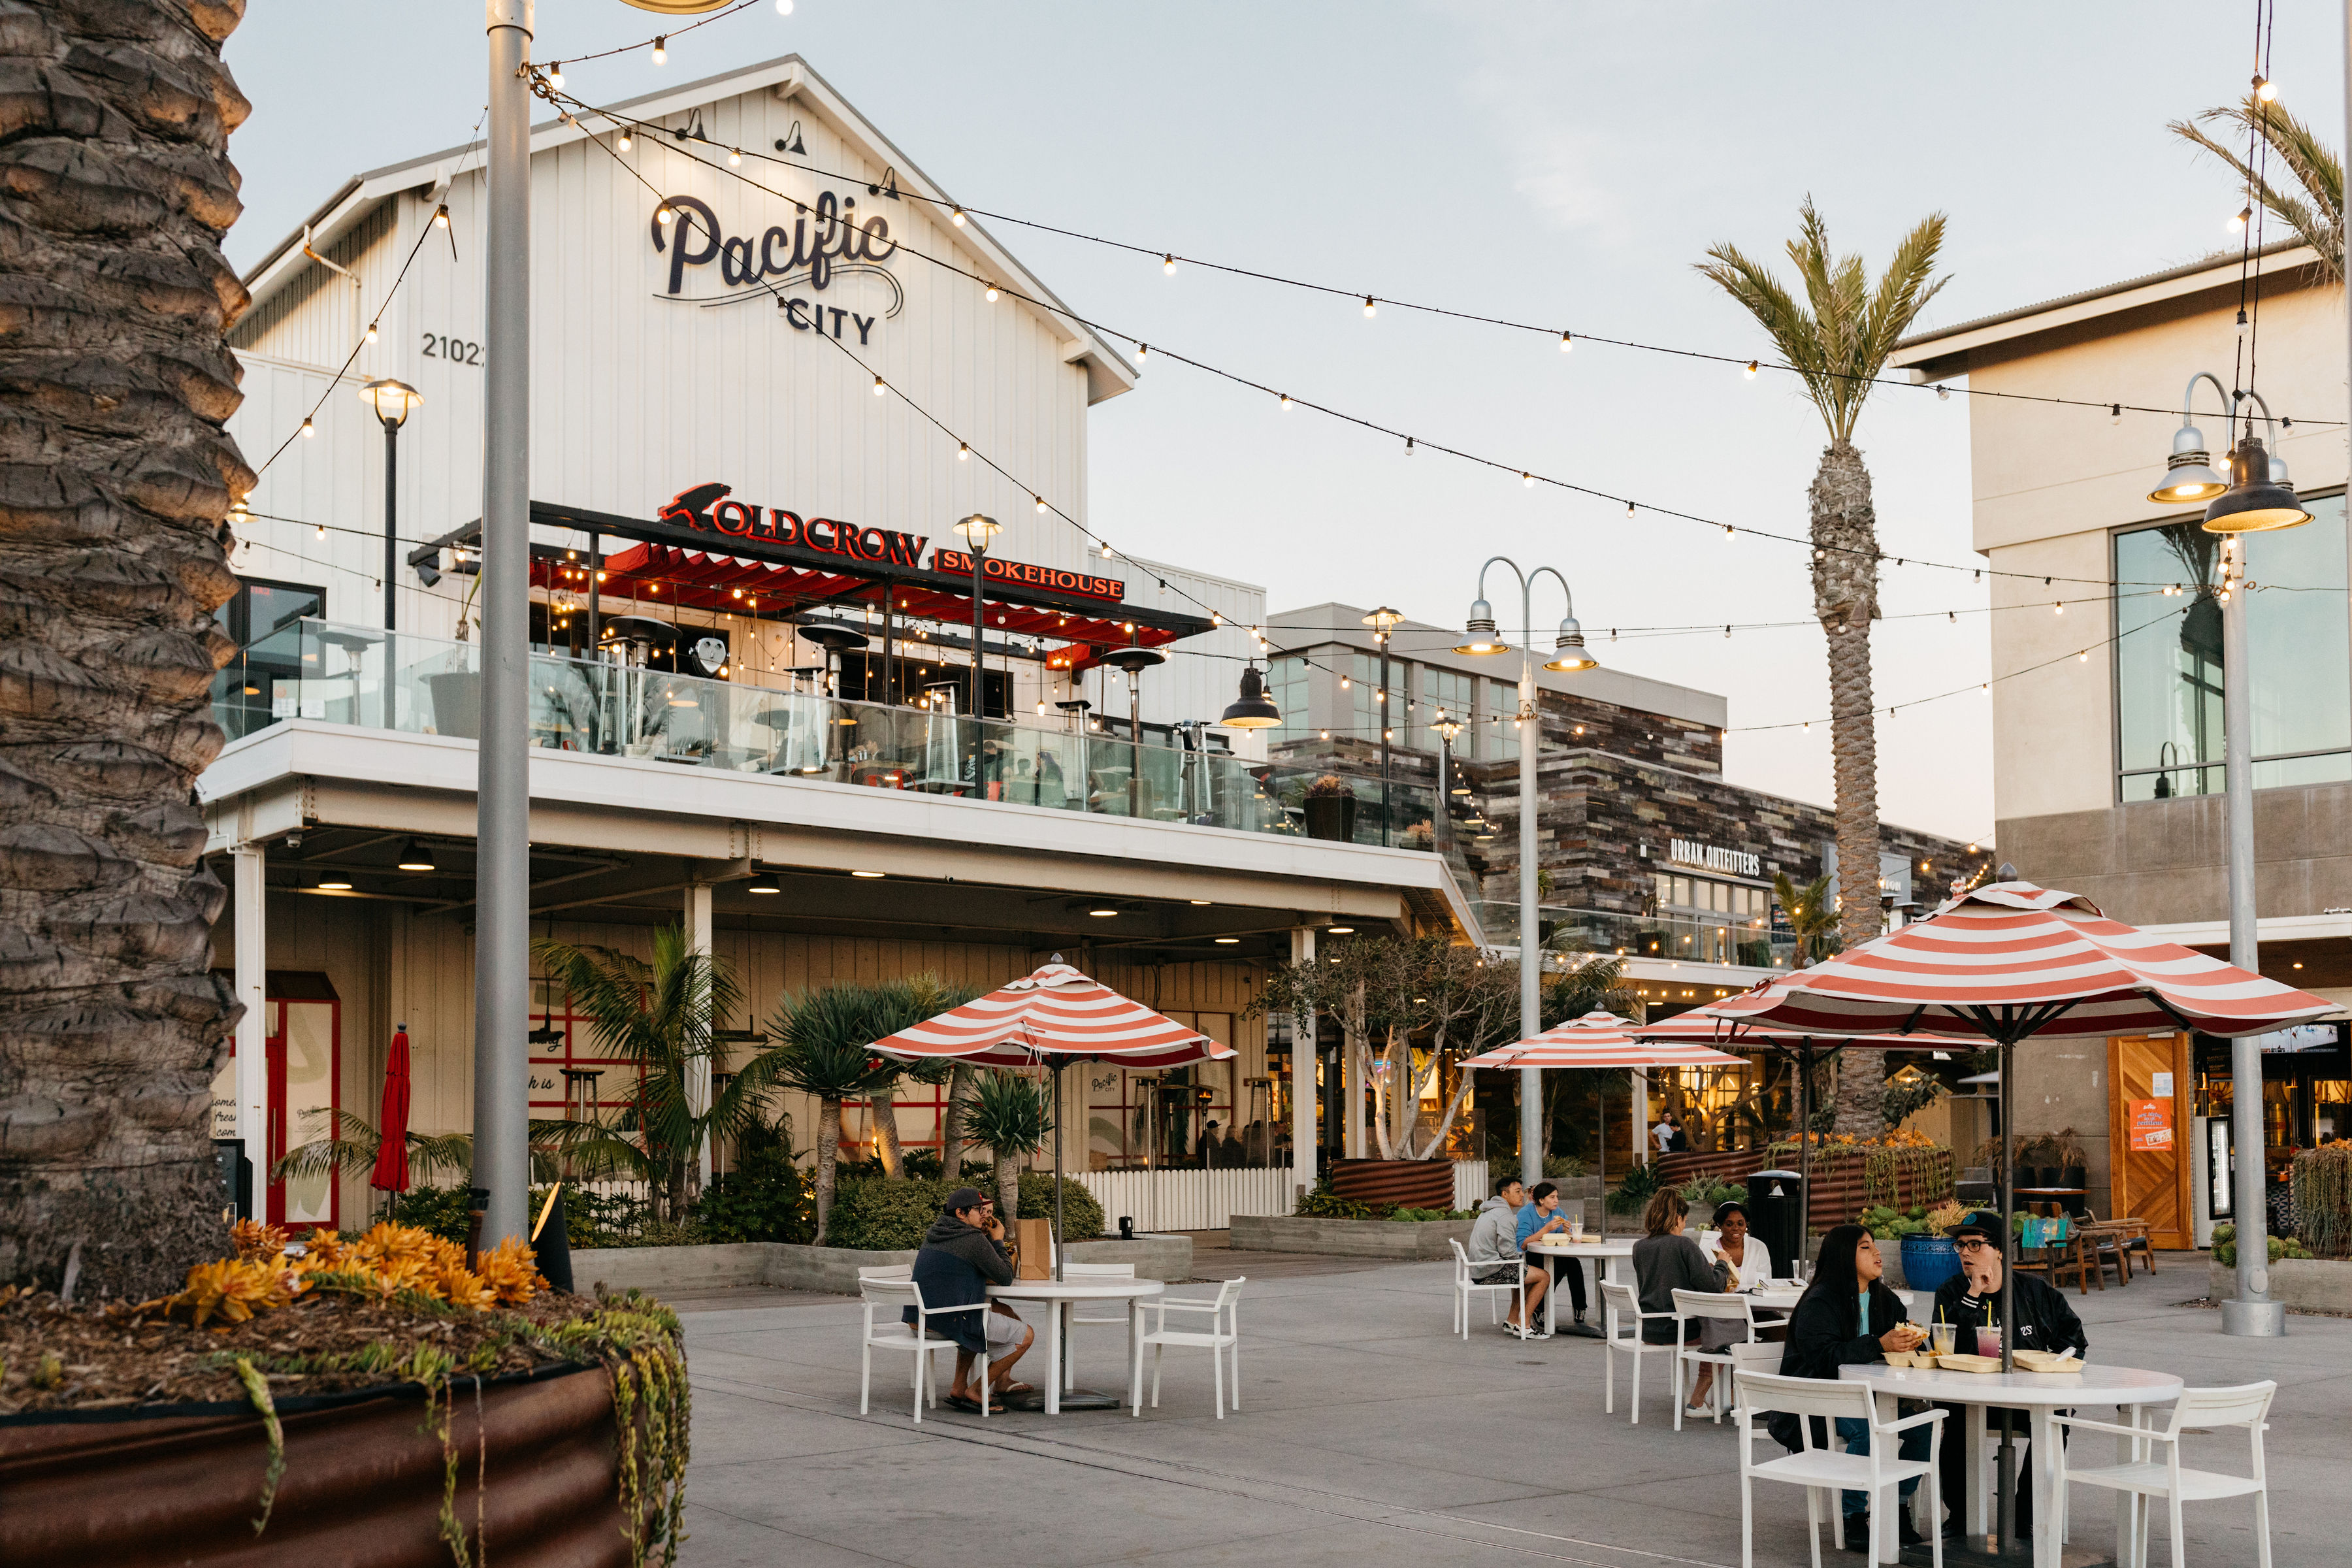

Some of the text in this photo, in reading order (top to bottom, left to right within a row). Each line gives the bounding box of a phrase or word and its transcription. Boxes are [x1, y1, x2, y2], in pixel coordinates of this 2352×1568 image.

[651, 191, 898, 293] Pacific
[787, 298, 875, 345] CITY
[423, 333, 485, 367] 2102
[1671, 838, 1760, 877] URBAN OUTFITTERS
[541, 1079, 555, 1089] is
[1092, 1073, 1118, 1092] Pacific
